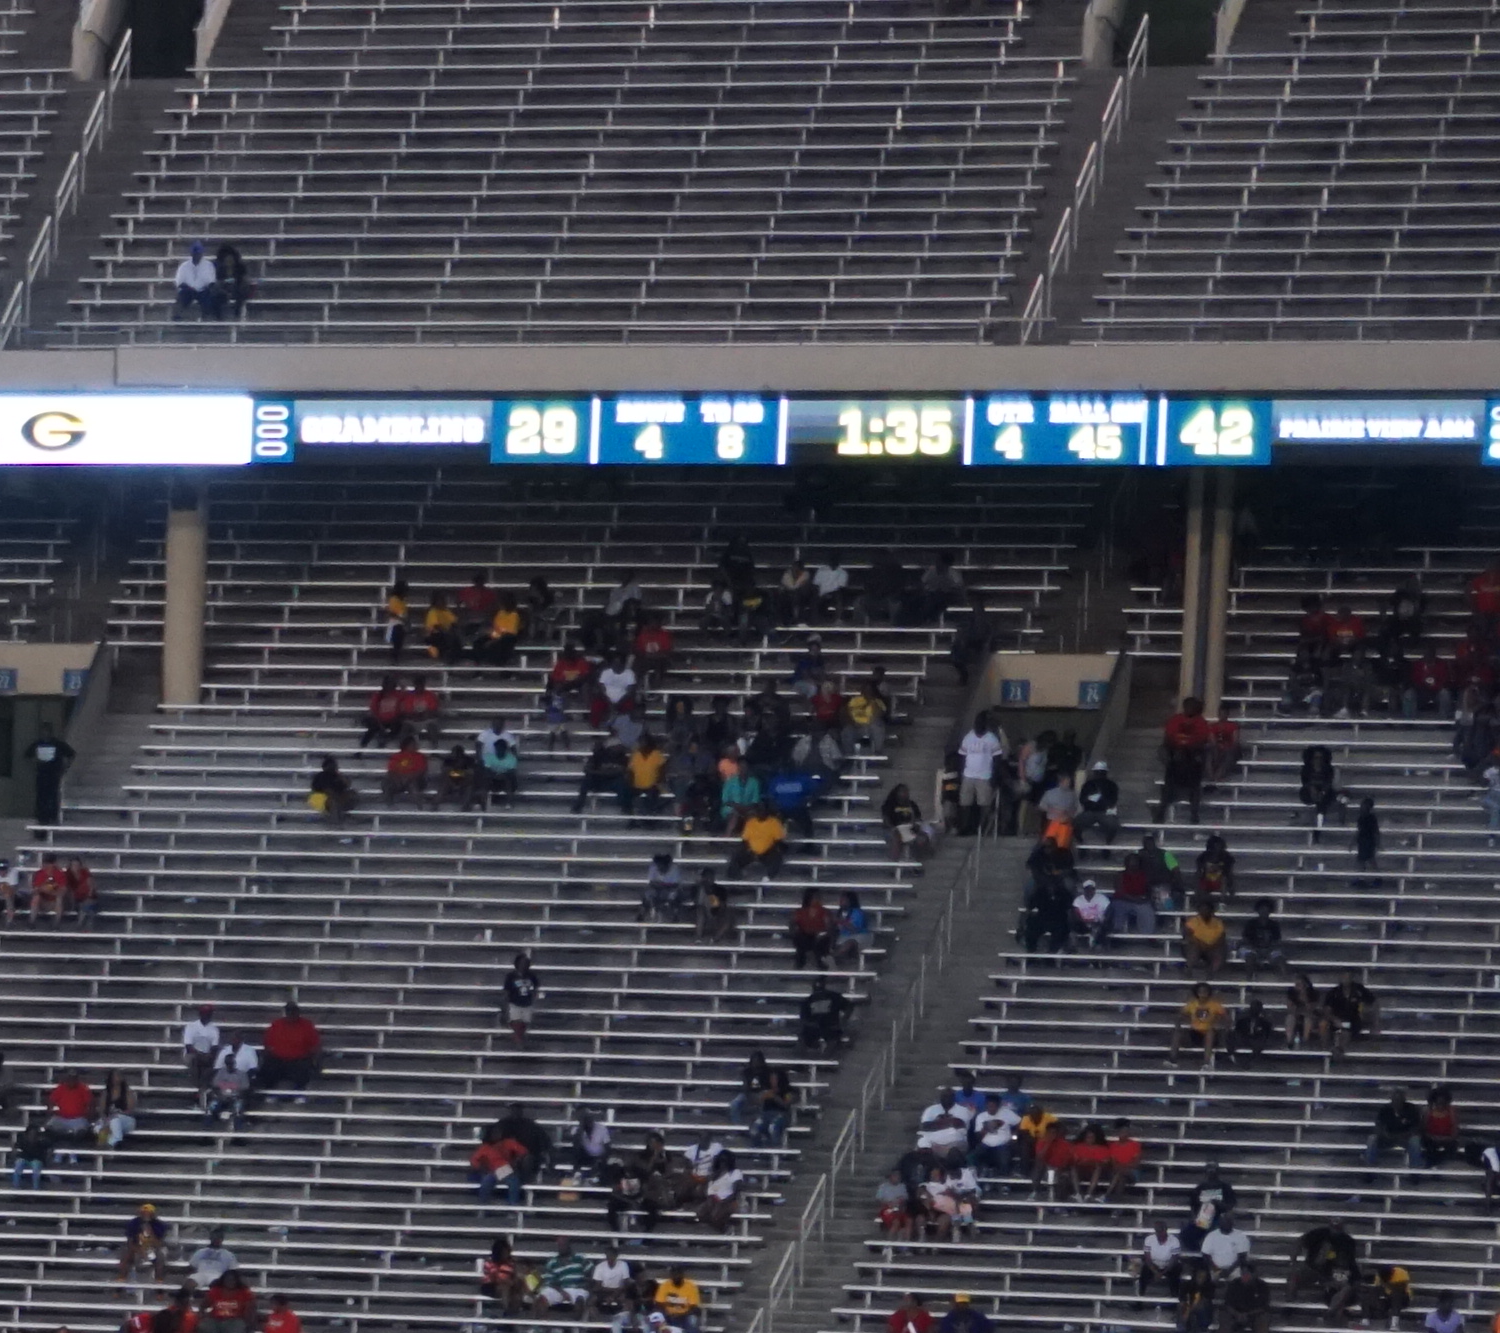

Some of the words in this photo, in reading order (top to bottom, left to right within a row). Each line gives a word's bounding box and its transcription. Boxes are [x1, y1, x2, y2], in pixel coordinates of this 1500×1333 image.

[21, 410, 85, 451] G
[507, 408, 577, 454] 29
[635, 425, 664, 458] 4
[717, 426, 744, 459] 8
[838, 409, 952, 455] 1:35
[996, 425, 1023, 458] 4
[1068, 425, 1122, 458] 45
[1180, 408, 1253, 455] 42
